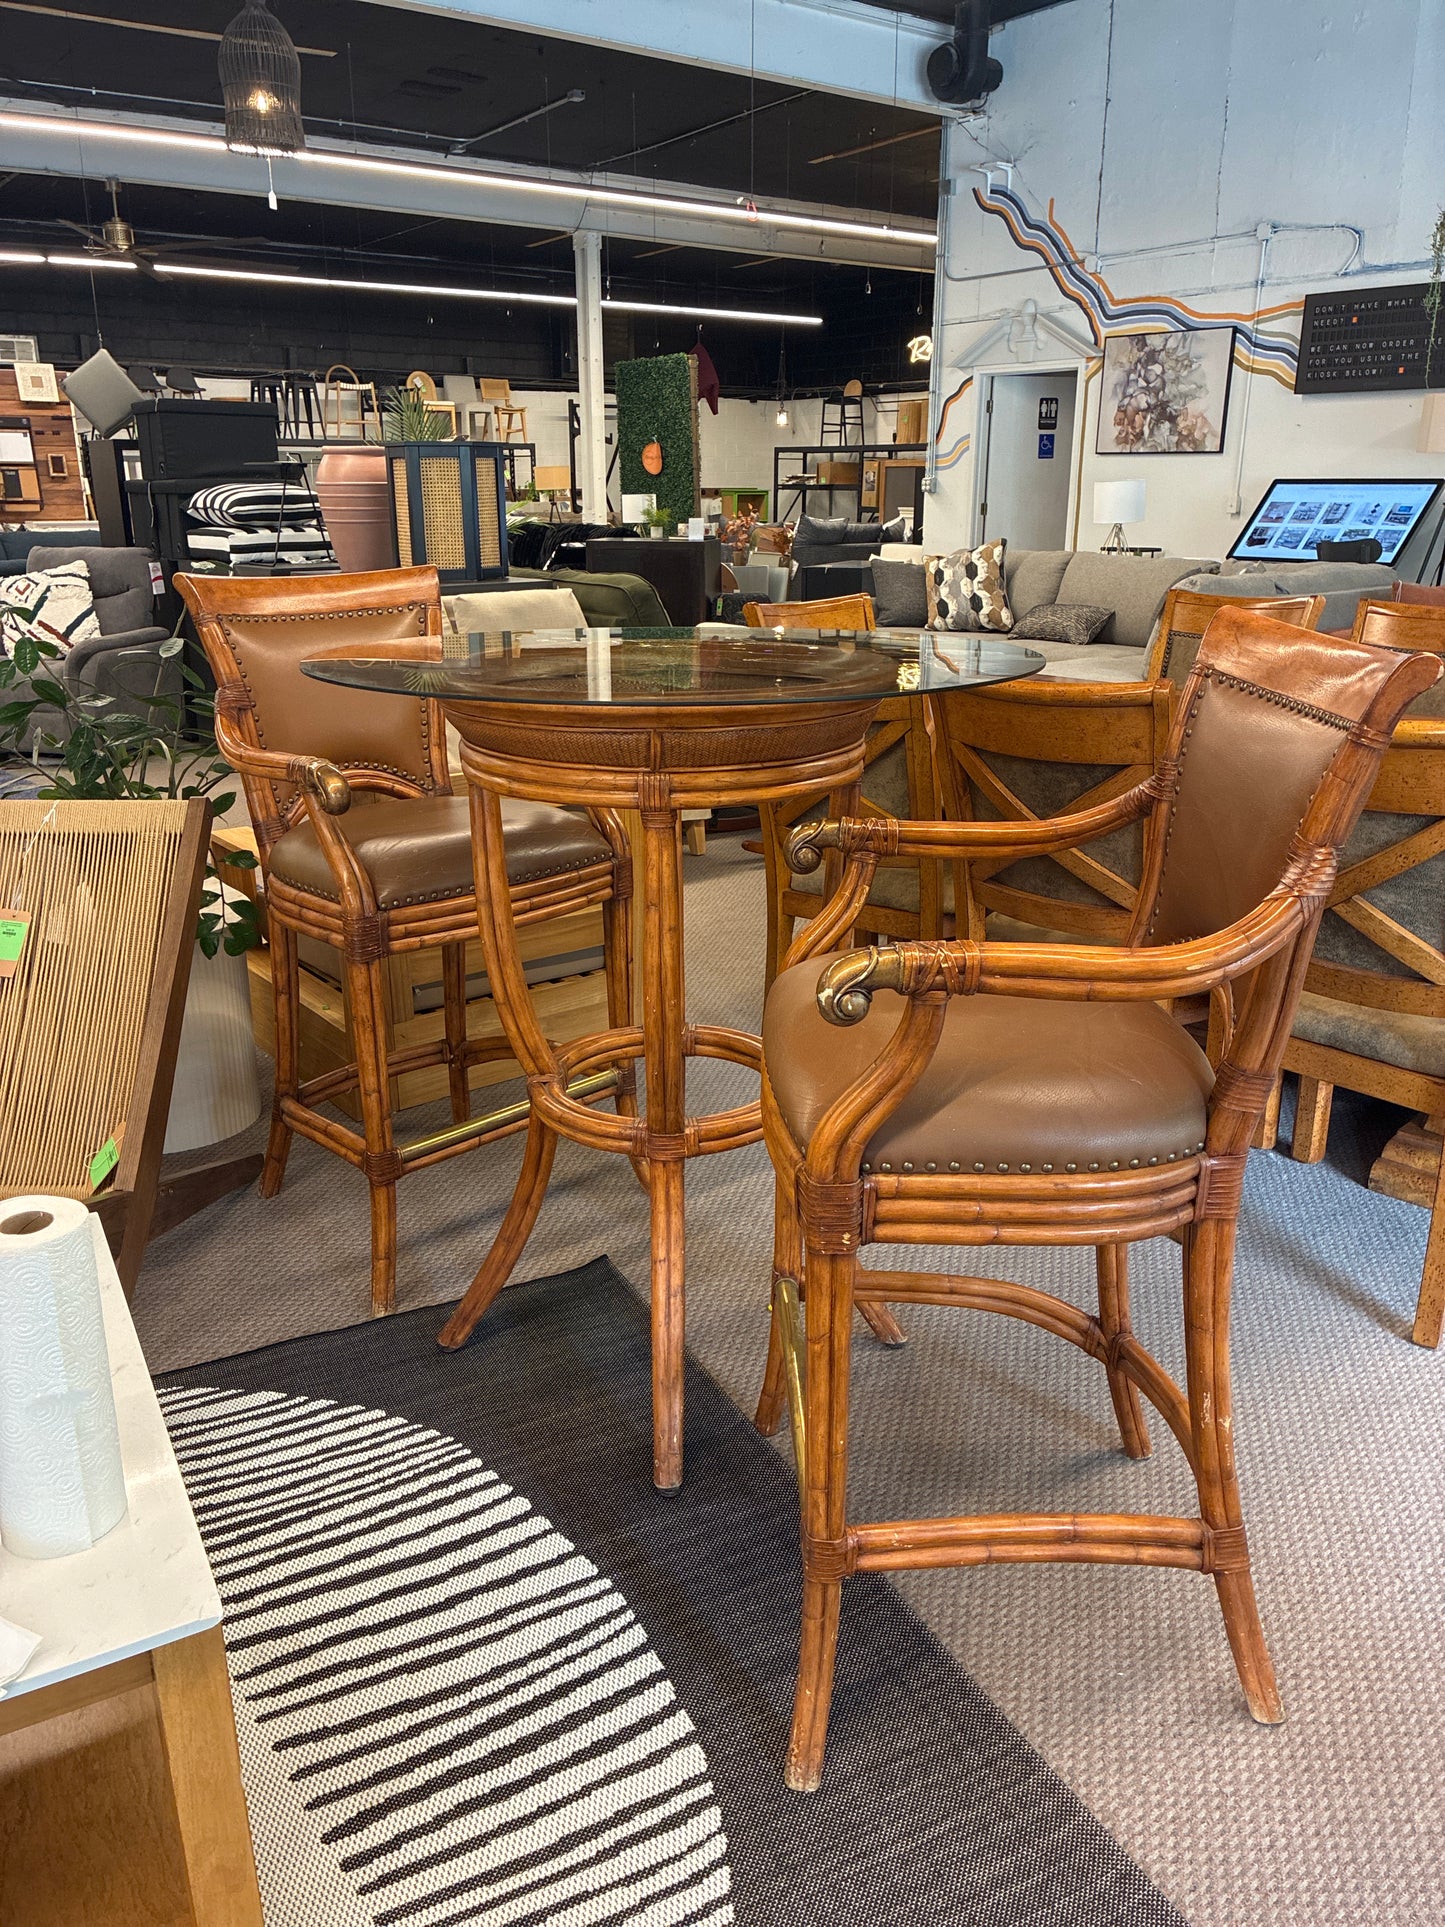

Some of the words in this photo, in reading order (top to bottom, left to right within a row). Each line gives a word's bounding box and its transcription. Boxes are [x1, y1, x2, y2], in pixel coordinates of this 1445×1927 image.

[1315, 304, 1346, 314] DON'T
[1353, 301, 1379, 310] HAVE
[1387, 298, 1413, 307] WHAT
[1313, 318, 1344, 327] NEED?
[1310, 345, 1321, 353] WE
[1329, 344, 1348, 352] CAN
[1355, 341, 1374, 350] NOW
[1382, 339, 1415, 348] ORDER
[1309, 358, 1326, 366] FOR
[1360, 354, 1392, 363] USING
[1400, 352, 1420, 360] THE
[1307, 370, 1337, 379] KIOSK
